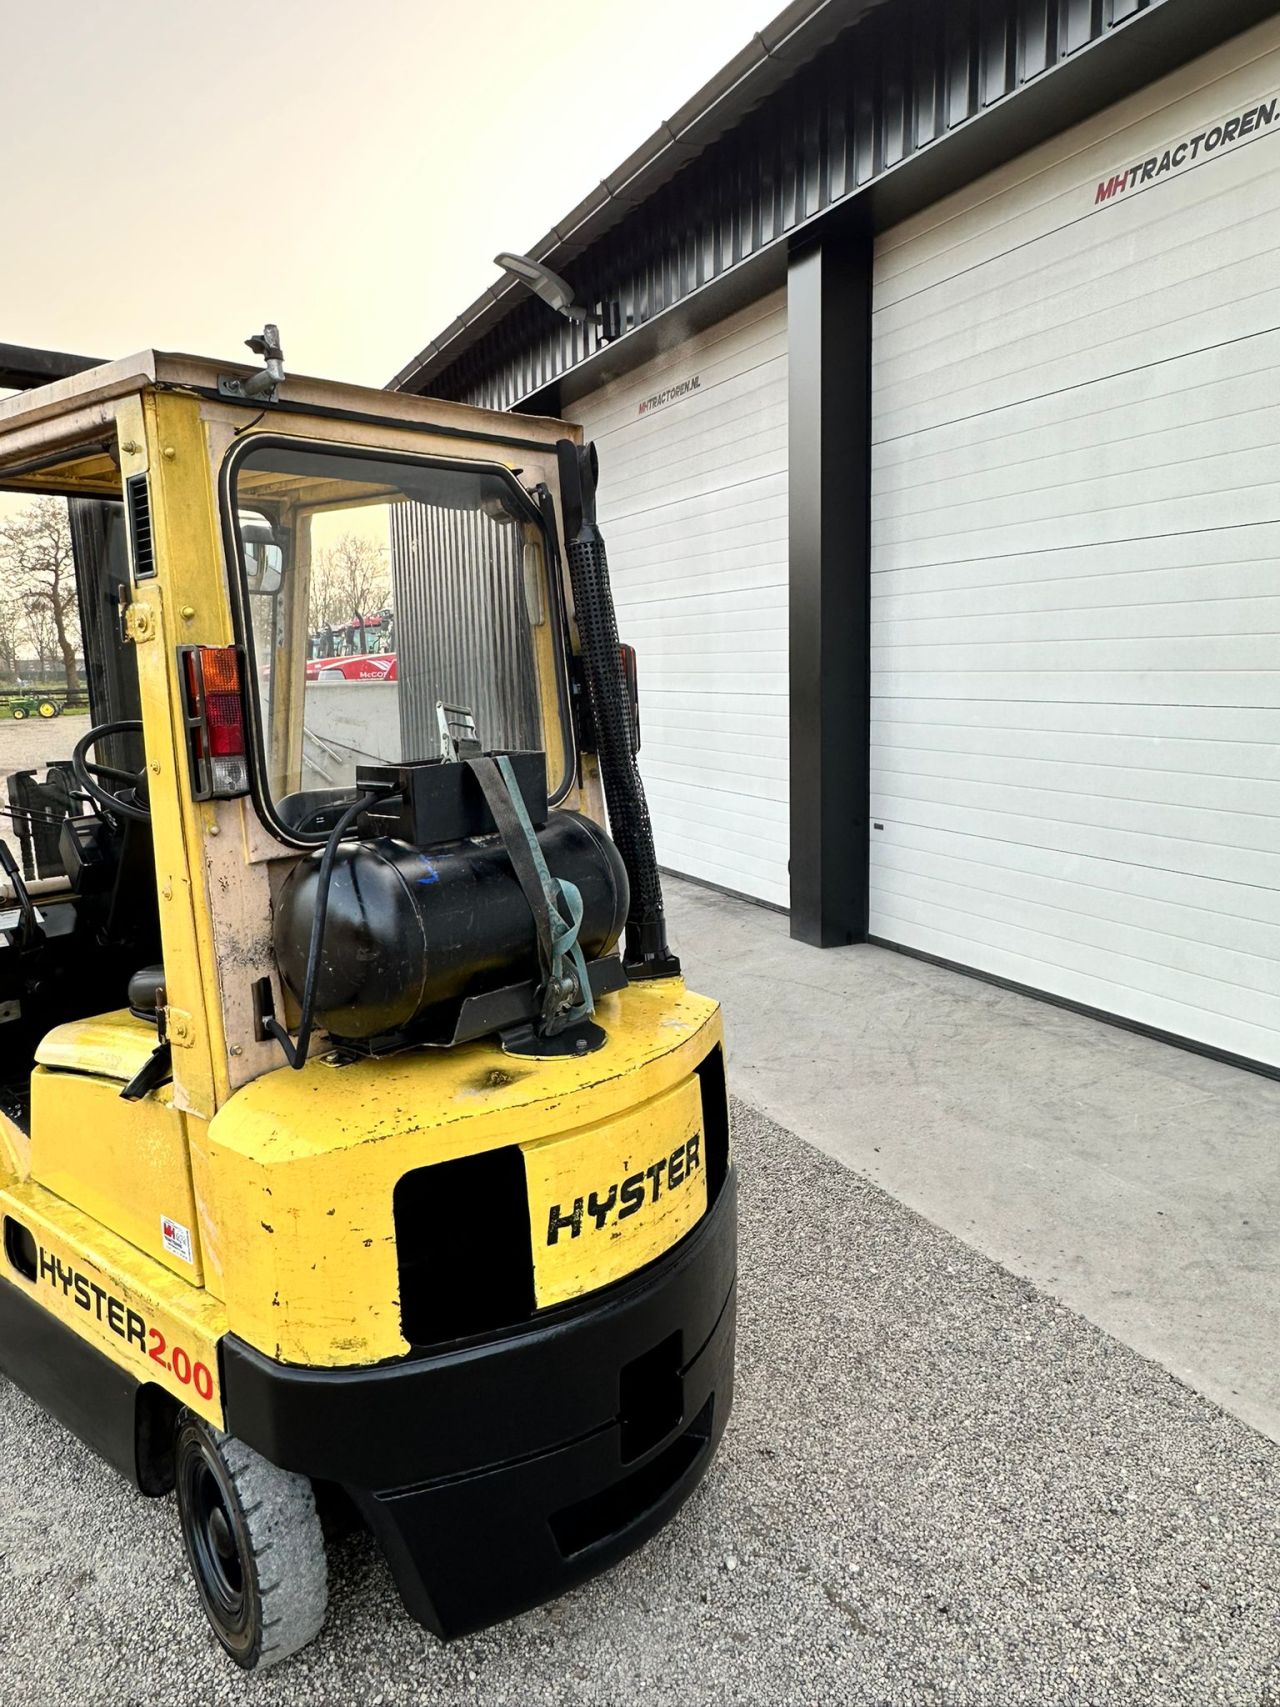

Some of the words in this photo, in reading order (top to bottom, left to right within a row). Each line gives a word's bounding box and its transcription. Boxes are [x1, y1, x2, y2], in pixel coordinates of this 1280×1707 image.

[638, 375, 701, 415] MHTRACTOREN.NL
[547, 1134, 700, 1246] HYSTER
[39, 1246, 146, 1354] HYSTER
[148, 1327, 213, 1401] 2.00
